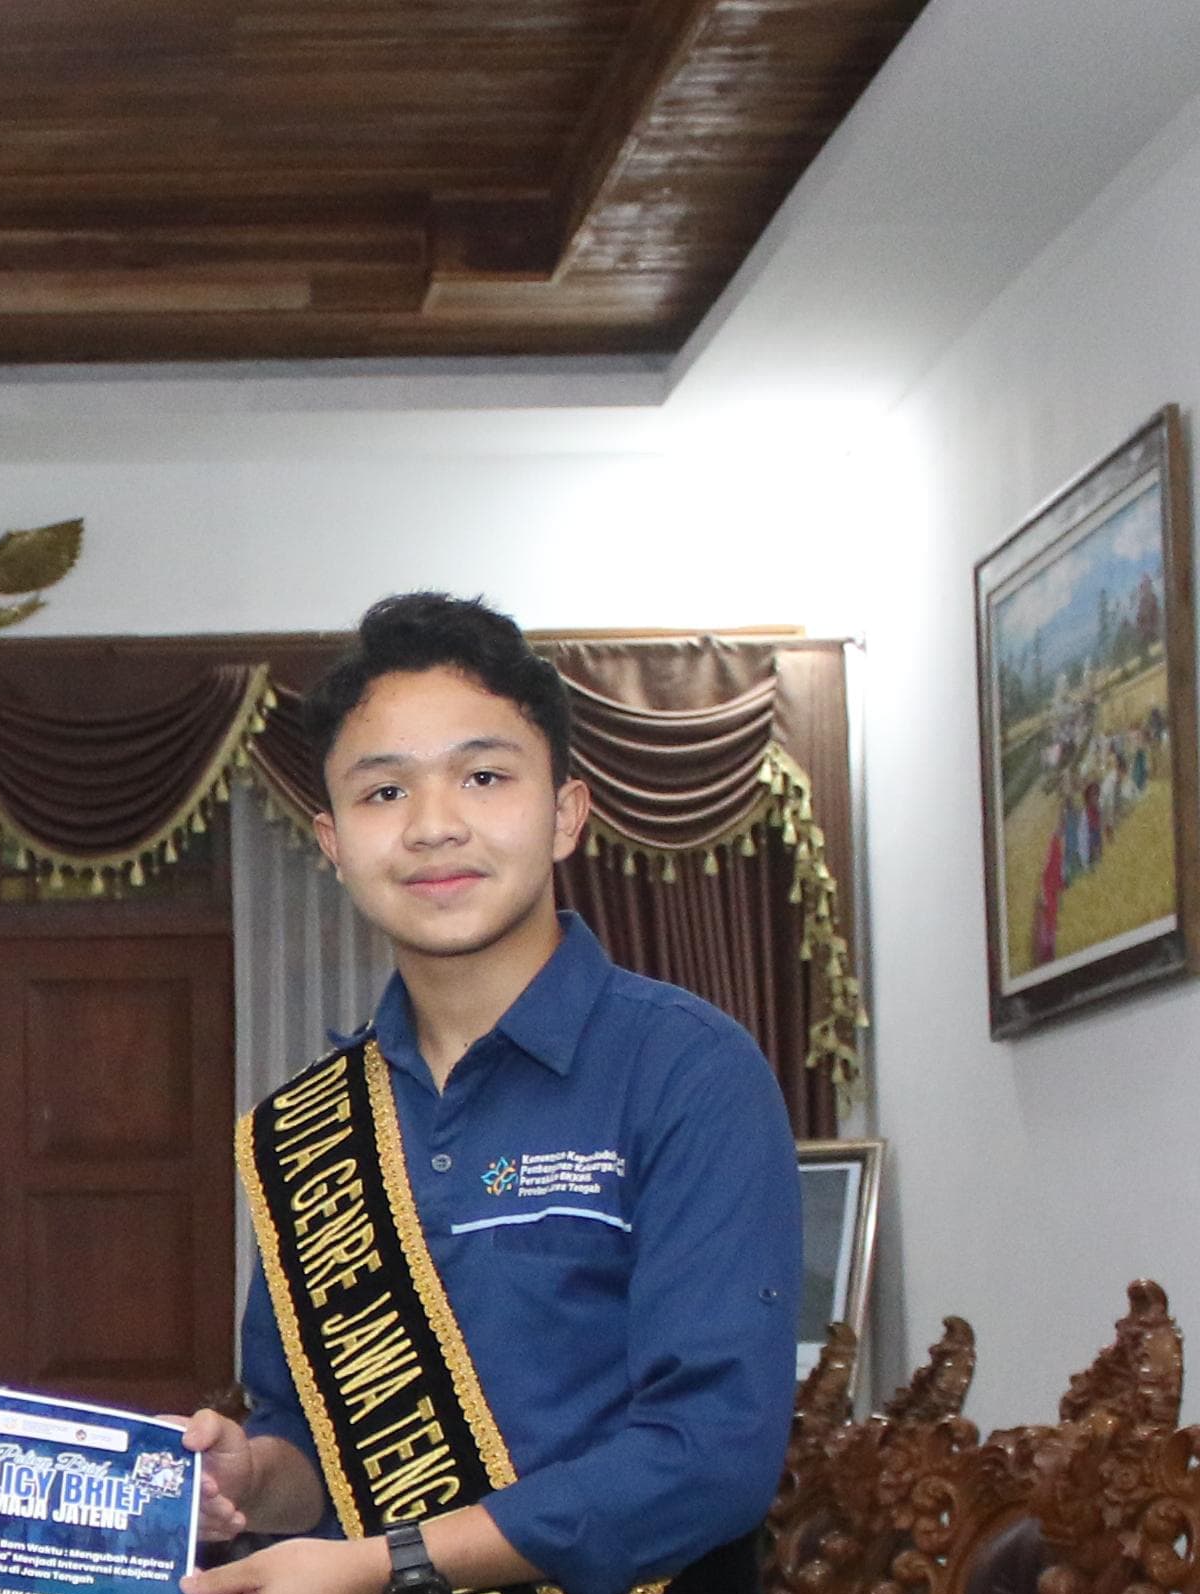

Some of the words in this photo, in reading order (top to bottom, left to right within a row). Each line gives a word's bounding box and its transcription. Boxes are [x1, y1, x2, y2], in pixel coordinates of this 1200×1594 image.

[273, 1055, 353, 1182] DUTA
[291, 1158, 383, 1309] GENRE
[321, 1291, 424, 1425] JAWA
[52, 1500, 129, 1530] JATENG
[62, 1470, 151, 1516] BRIEF
[356, 1395, 460, 1523] TENG
[21, 1567, 50, 1579] Jawa
[52, 1571, 94, 1585] Tengah
